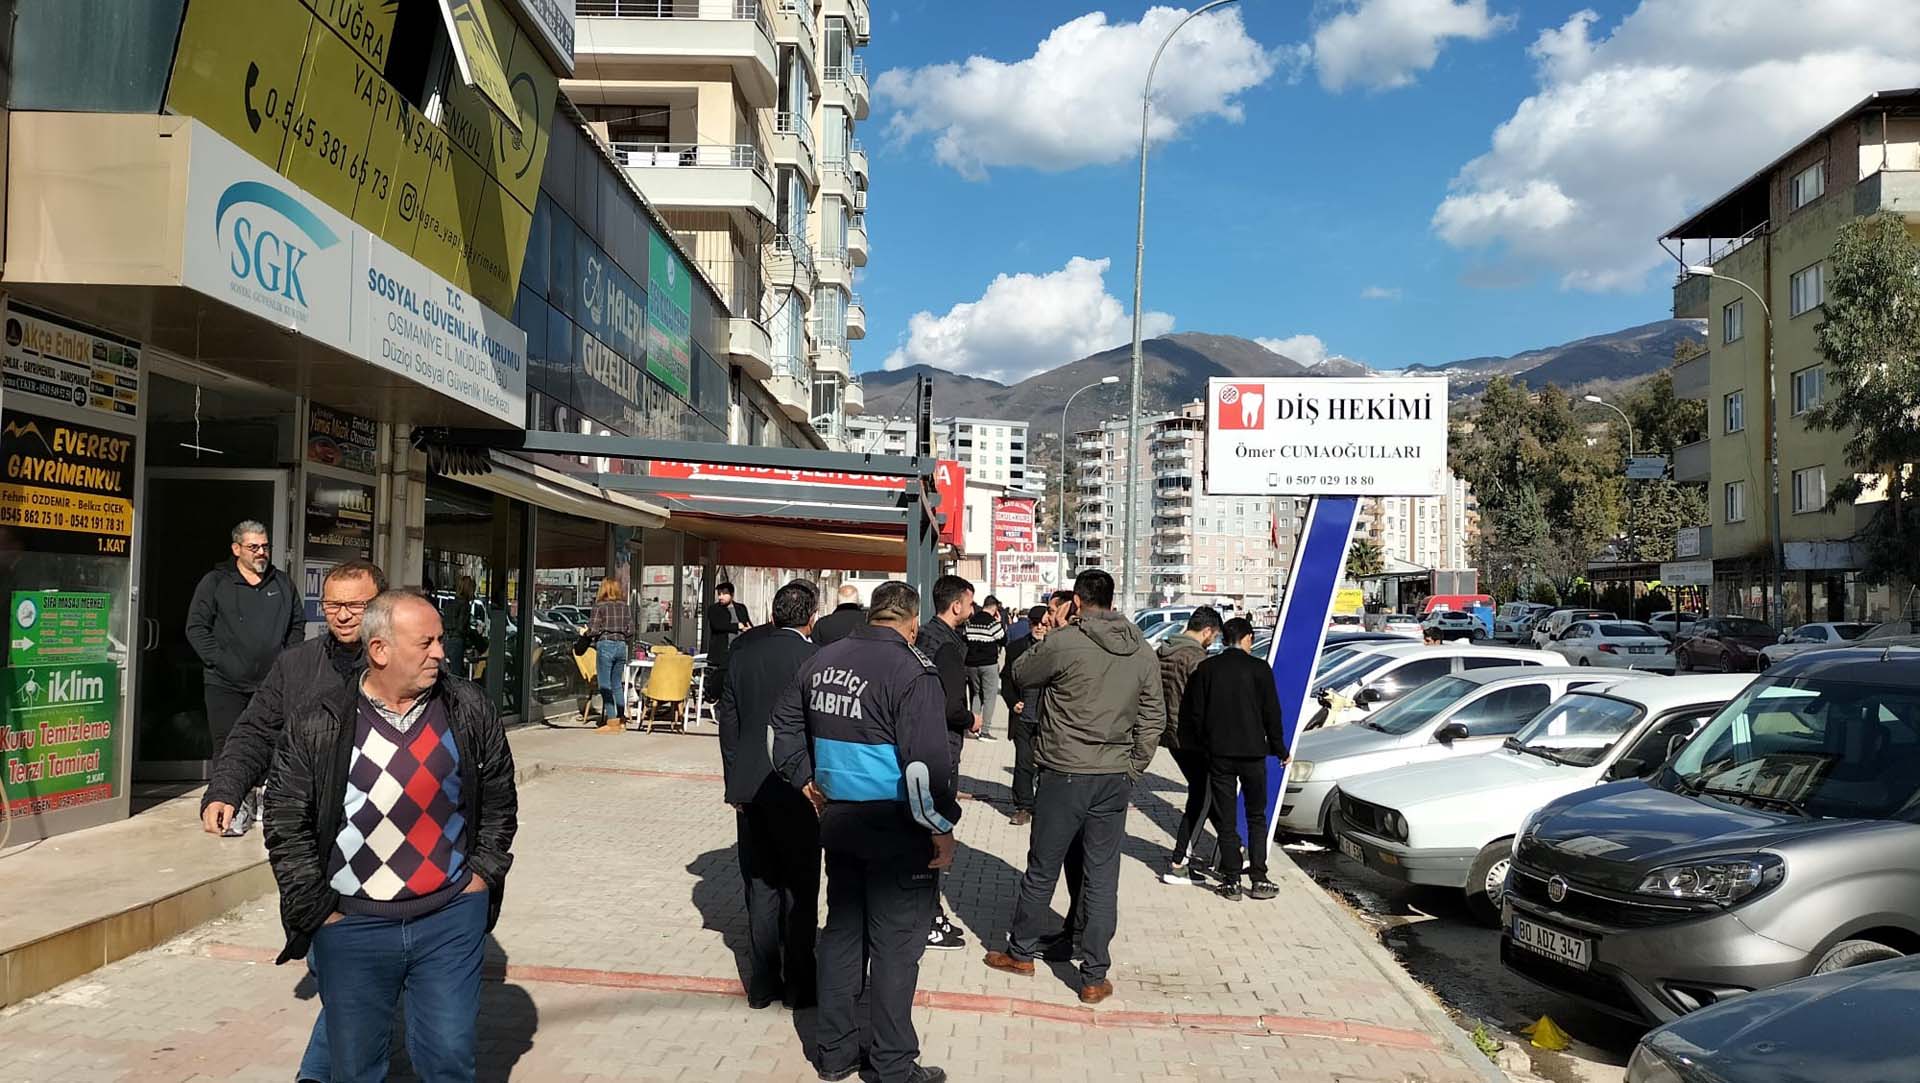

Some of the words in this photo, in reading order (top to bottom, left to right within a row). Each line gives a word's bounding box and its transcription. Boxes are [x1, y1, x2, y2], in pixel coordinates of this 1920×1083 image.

[353, 63, 394, 122] YAPI
[441, 101, 481, 158] ENKUL
[319, 130, 348, 171] 381
[350, 154, 369, 186] 65
[372, 168, 389, 201] 73
[231, 216, 308, 308] SGK
[446, 287, 465, 313] T.C.
[368, 267, 419, 316] SOSYAL
[423, 300, 478, 349] GÜVENLİK
[482, 335, 520, 372] KURUMU
[24, 321, 52, 358] Akçe
[56, 331, 91, 364] Emlak
[387, 311, 443, 357] OSMANİYE
[444, 337, 453, 363] İL
[455, 349, 508, 390] MÜDÜRLÜĞÜ
[382, 338, 413, 370] Düziçi
[415, 354, 445, 384] Sosyal
[447, 369, 481, 401] Güvenlik
[482, 387, 510, 415] Merkezi
[582, 331, 639, 406] GÜZELLİK
[1277, 392, 1319, 425] DİŞ
[1328, 392, 1432, 420] HEKİMİ
[53, 427, 130, 463] EVEREST
[1235, 442, 1276, 459] Ömer
[1280, 443, 1421, 459] CUMAOĞULLARI
[8, 454, 121, 491] GAYRİMENKUL
[1286, 476, 1293, 486] 0
[1296, 476, 1316, 486] 507
[1320, 476, 1340, 486] 029
[1345, 476, 1358, 486] 18
[1361, 476, 1375, 486] 80
[31, 491, 71, 508] ÖZDEMİR
[1, 507, 22, 521] 0545
[24, 510, 39, 524] 862
[42, 511, 51, 525] 75
[54, 513, 64, 526] 10
[70, 514, 89, 528] 0542
[91, 516, 104, 530] 191
[106, 518, 114, 531] 78
[117, 519, 124, 531] 31
[98, 538, 126, 553] 1.KAT
[48, 670, 104, 703] iklim
[812, 666, 869, 697] DÜZİÇİ
[810, 689, 863, 720] ZABITA
[0, 724, 35, 752] Kuru
[39, 716, 111, 747] Temizleme
[8, 754, 45, 785] Terzi
[48, 748, 100, 778] Tamirat
[1519, 921, 1532, 942] 80
[1537, 928, 1556, 951] ADZ
[1560, 935, 1582, 960] 347
